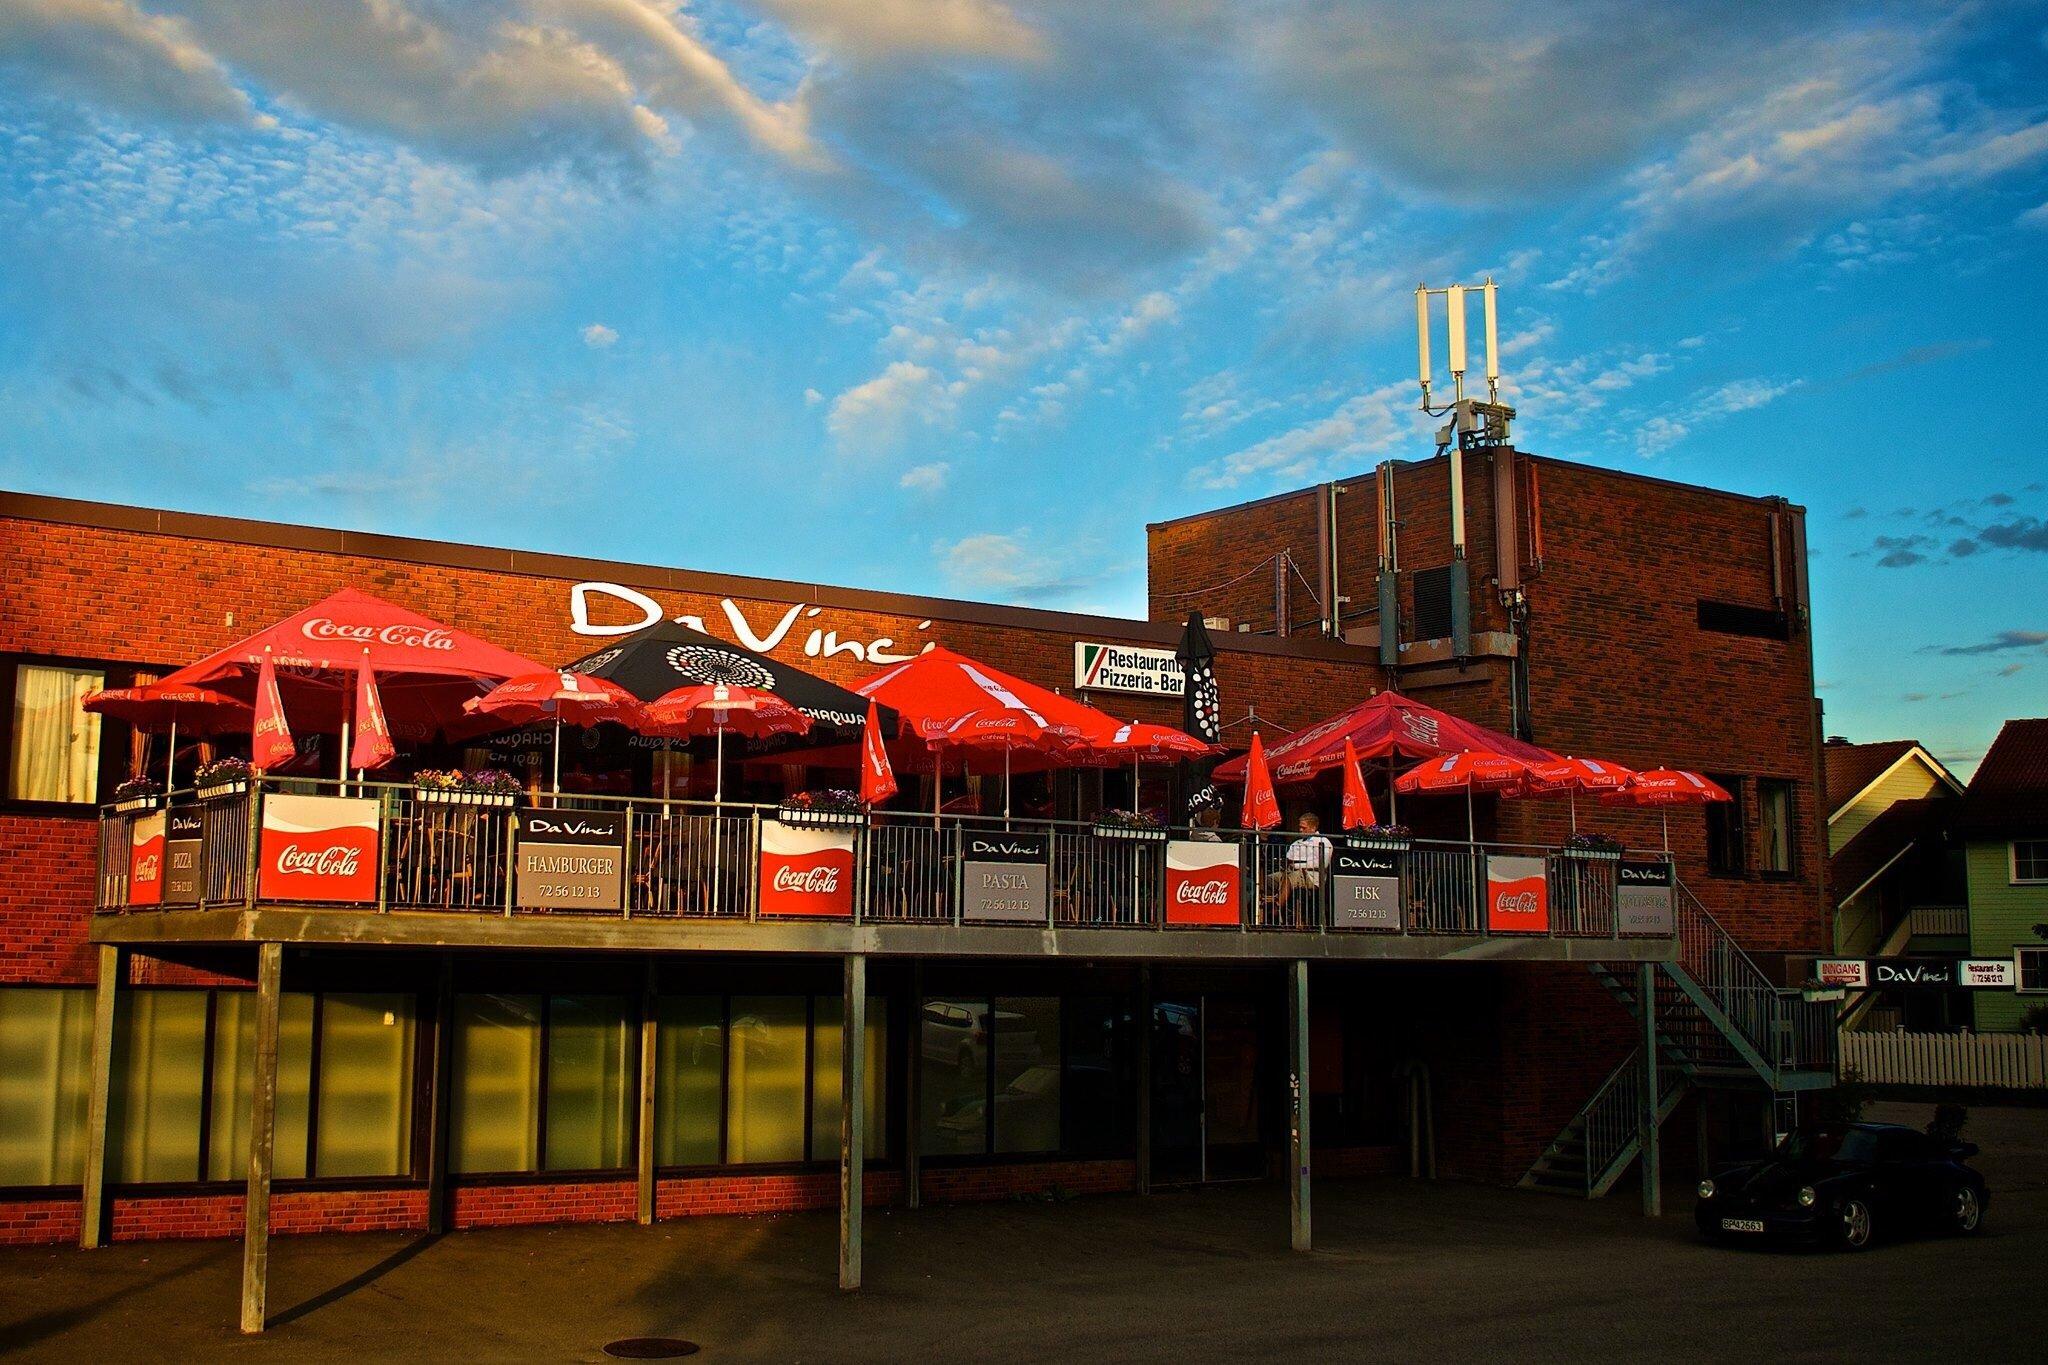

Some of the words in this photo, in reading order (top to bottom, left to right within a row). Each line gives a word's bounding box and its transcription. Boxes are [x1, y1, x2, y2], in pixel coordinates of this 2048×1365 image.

[302, 617, 456, 651] Coca-Cola
[173, 852, 192, 869] PIZZA
[277, 844, 362, 876] Coca-Cola
[527, 856, 613, 875] HAMBURGER
[773, 865, 840, 893] Coca-Cola
[982, 872, 1029, 890] PASTA
[540, 885, 553, 896] 72
[555, 885, 569, 897] 56
[572, 886, 584, 897] 12
[588, 886, 600, 898] 13
[1176, 879, 1229, 905] Coca-Cola
[1354, 886, 1380, 900] FISK
[1496, 892, 1538, 913] Coca-Cola
[1822, 963, 1861, 974] INNGANG
